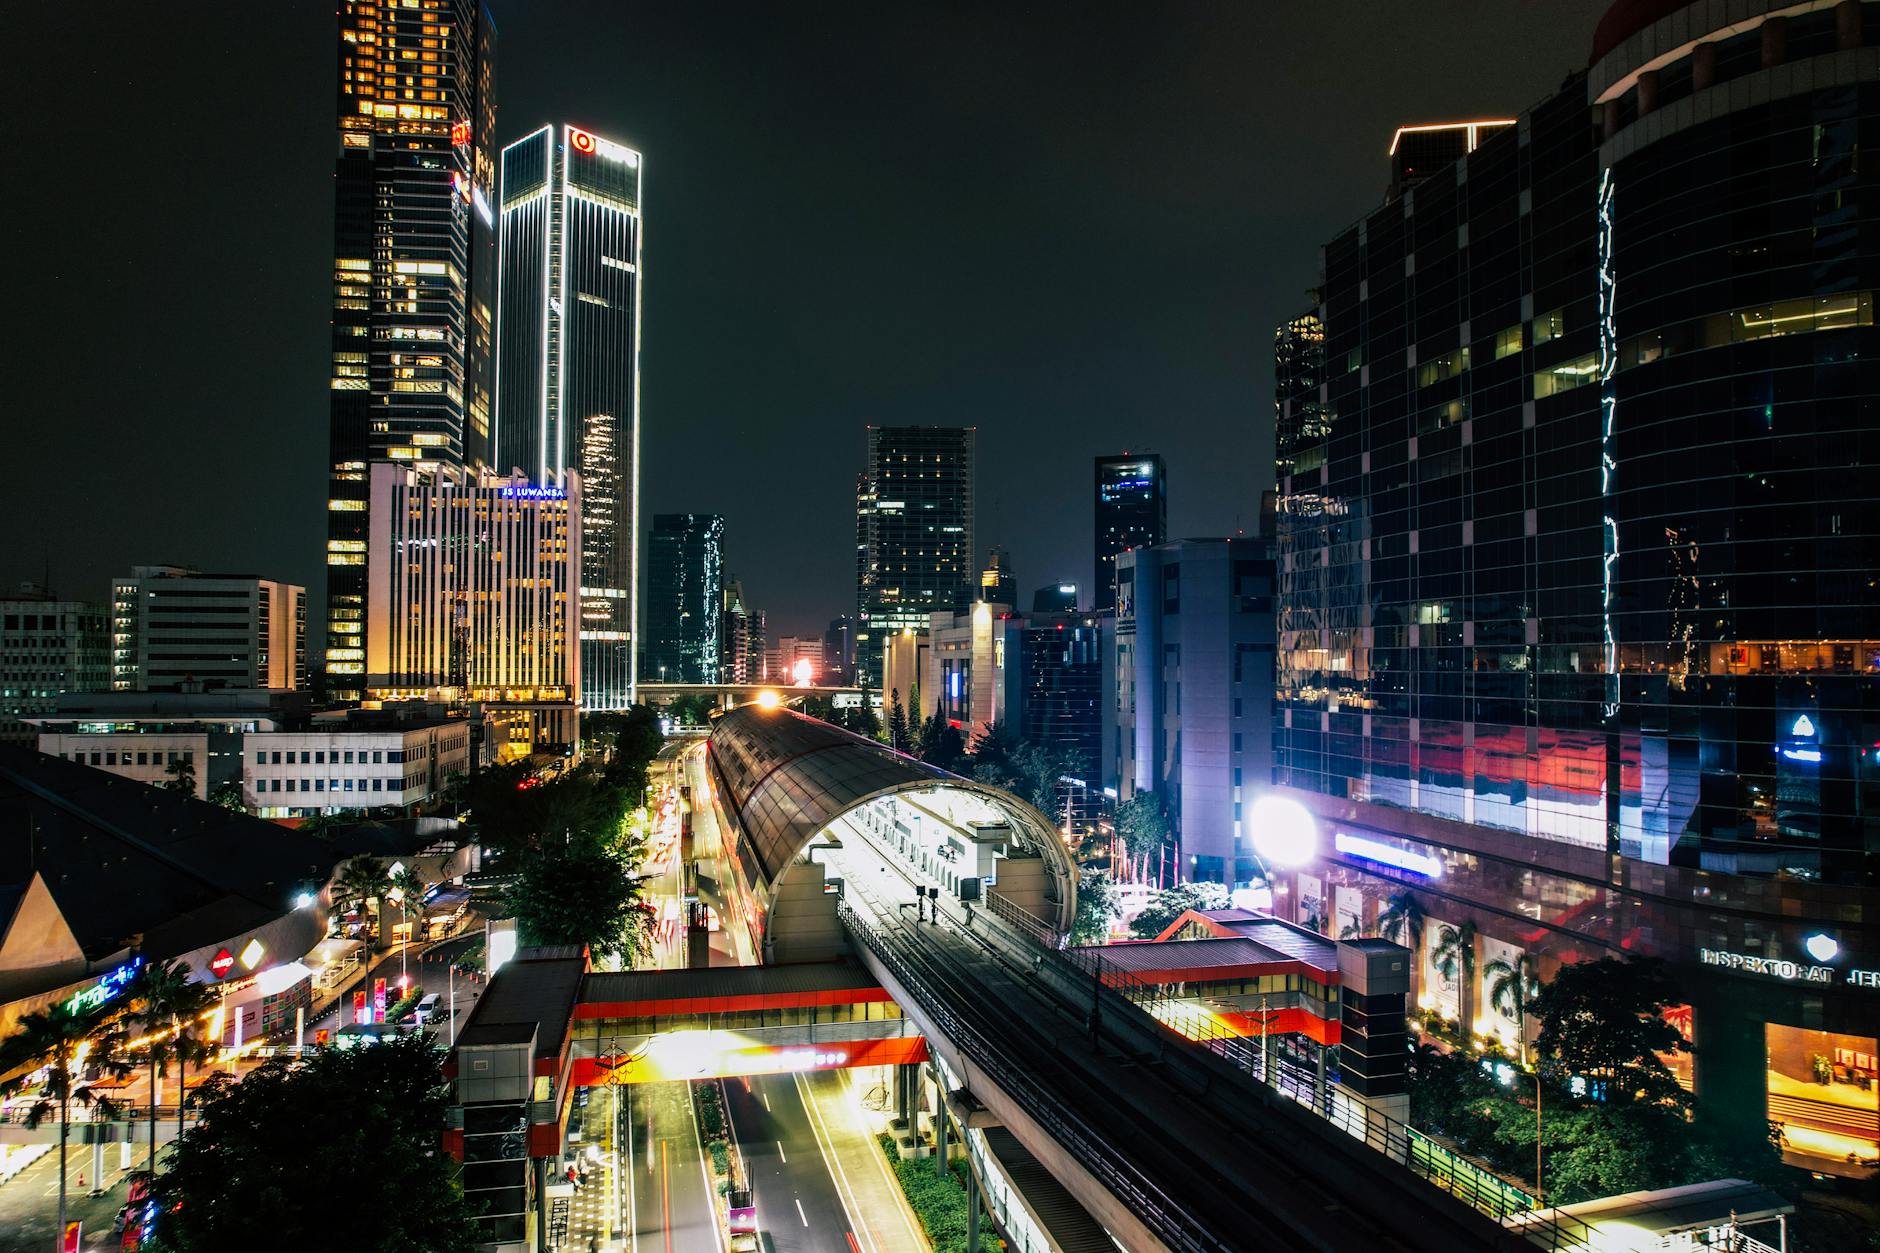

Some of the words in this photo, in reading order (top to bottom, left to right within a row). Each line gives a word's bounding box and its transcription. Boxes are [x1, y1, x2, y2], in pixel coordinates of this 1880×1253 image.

[502, 487, 513, 496] JS
[516, 487, 564, 497] LUWANSA
[1700, 947, 1834, 982] INSPEKTORAT
